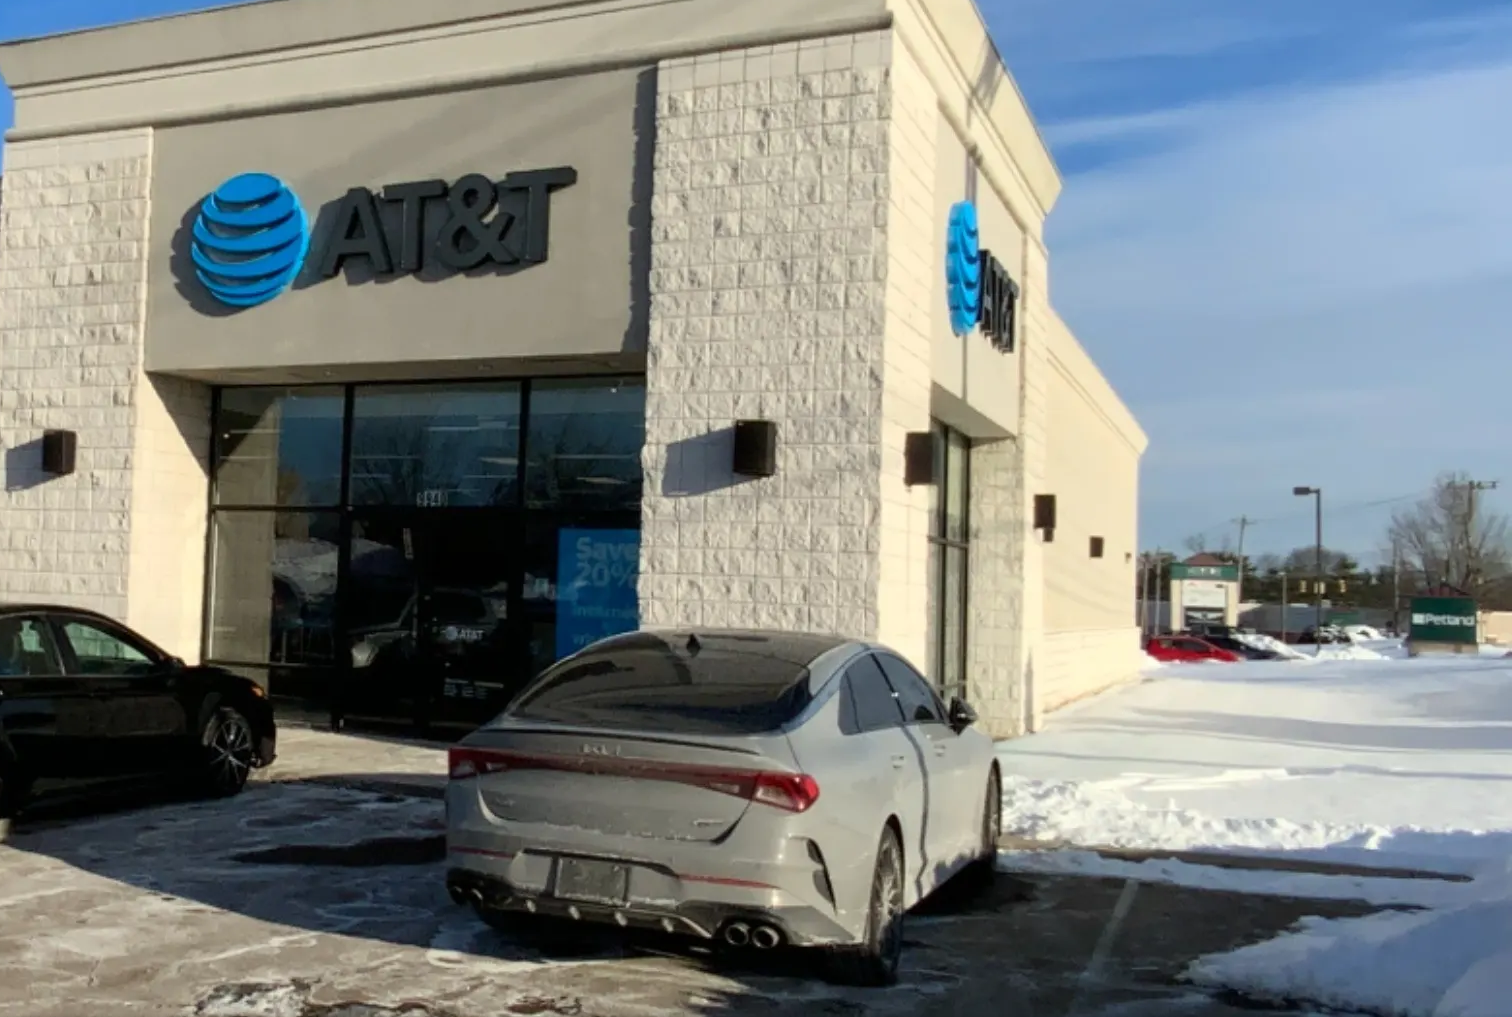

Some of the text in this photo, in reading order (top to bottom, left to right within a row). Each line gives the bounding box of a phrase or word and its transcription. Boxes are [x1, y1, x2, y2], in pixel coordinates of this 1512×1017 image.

[321, 165, 578, 276] AT&T
[576, 536, 638, 561] Save
[574, 562, 637, 587] 20%
[1425, 613, 1476, 627] Petland
[458, 629, 484, 641] AT&T
